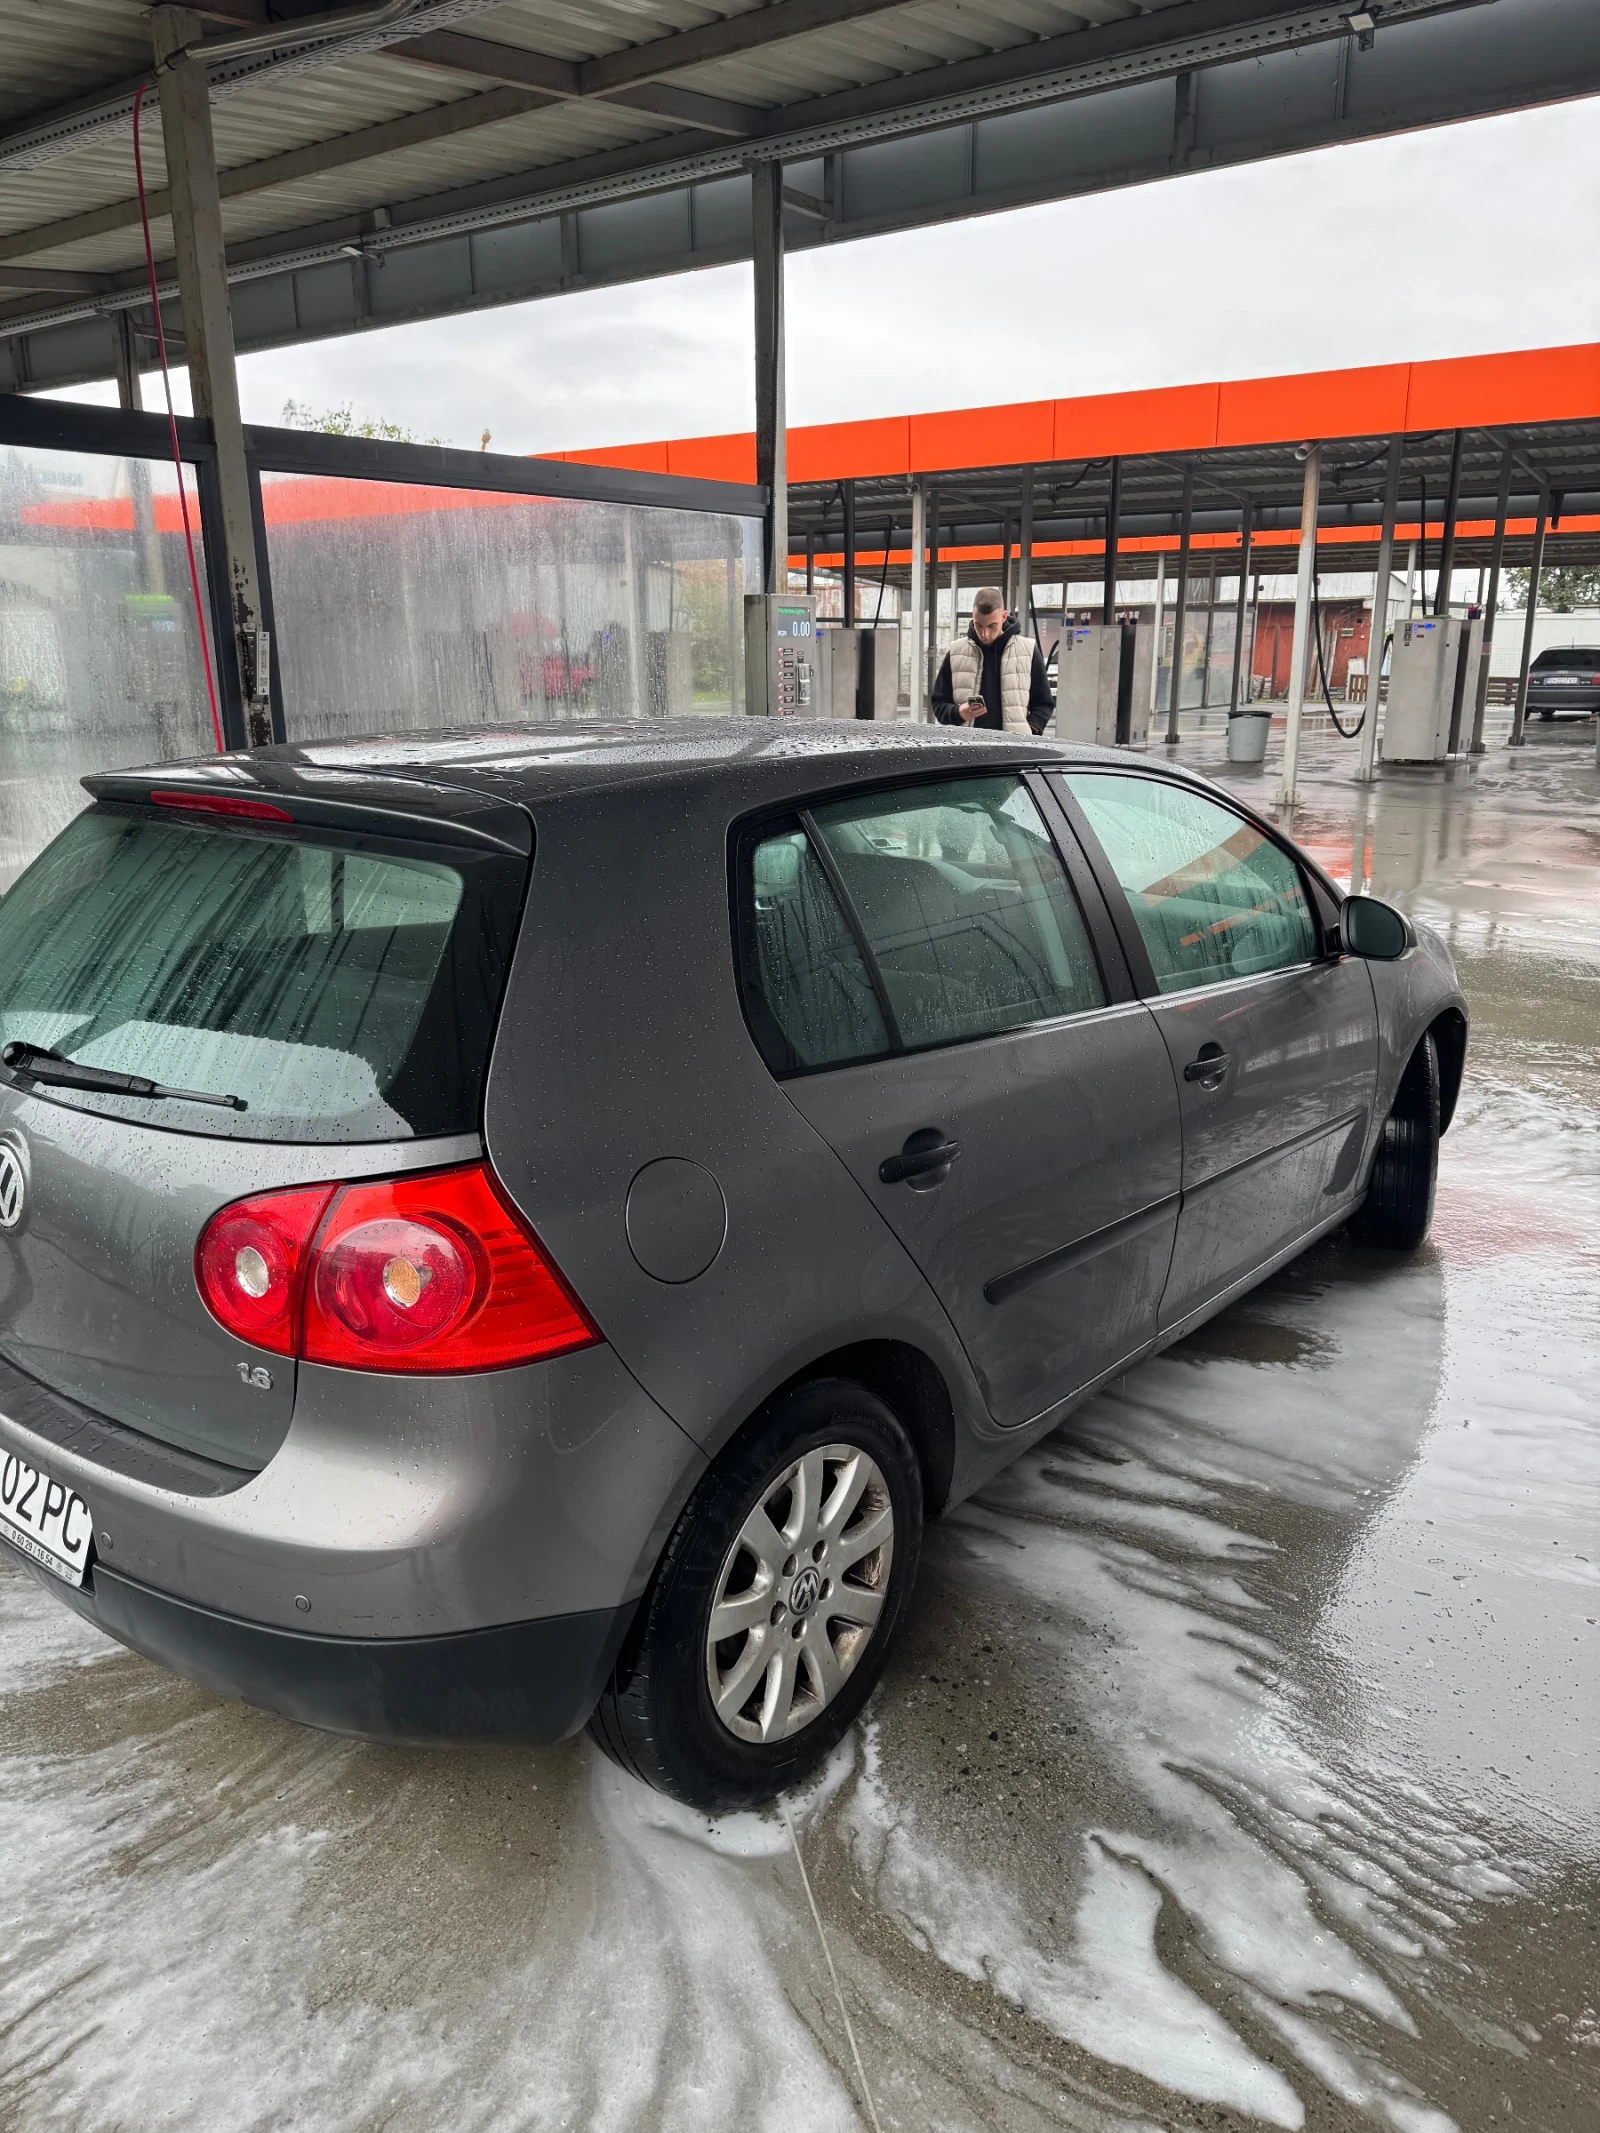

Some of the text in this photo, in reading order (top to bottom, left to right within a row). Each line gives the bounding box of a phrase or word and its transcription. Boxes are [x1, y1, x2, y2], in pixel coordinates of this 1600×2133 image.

[792, 621, 810, 637] 0.00
[236, 1362, 274, 1390] 1.6
[24, 1539, 33, 1552] 29
[37, 1549, 45, 1560] 16
[44, 1555, 54, 1566] 54
